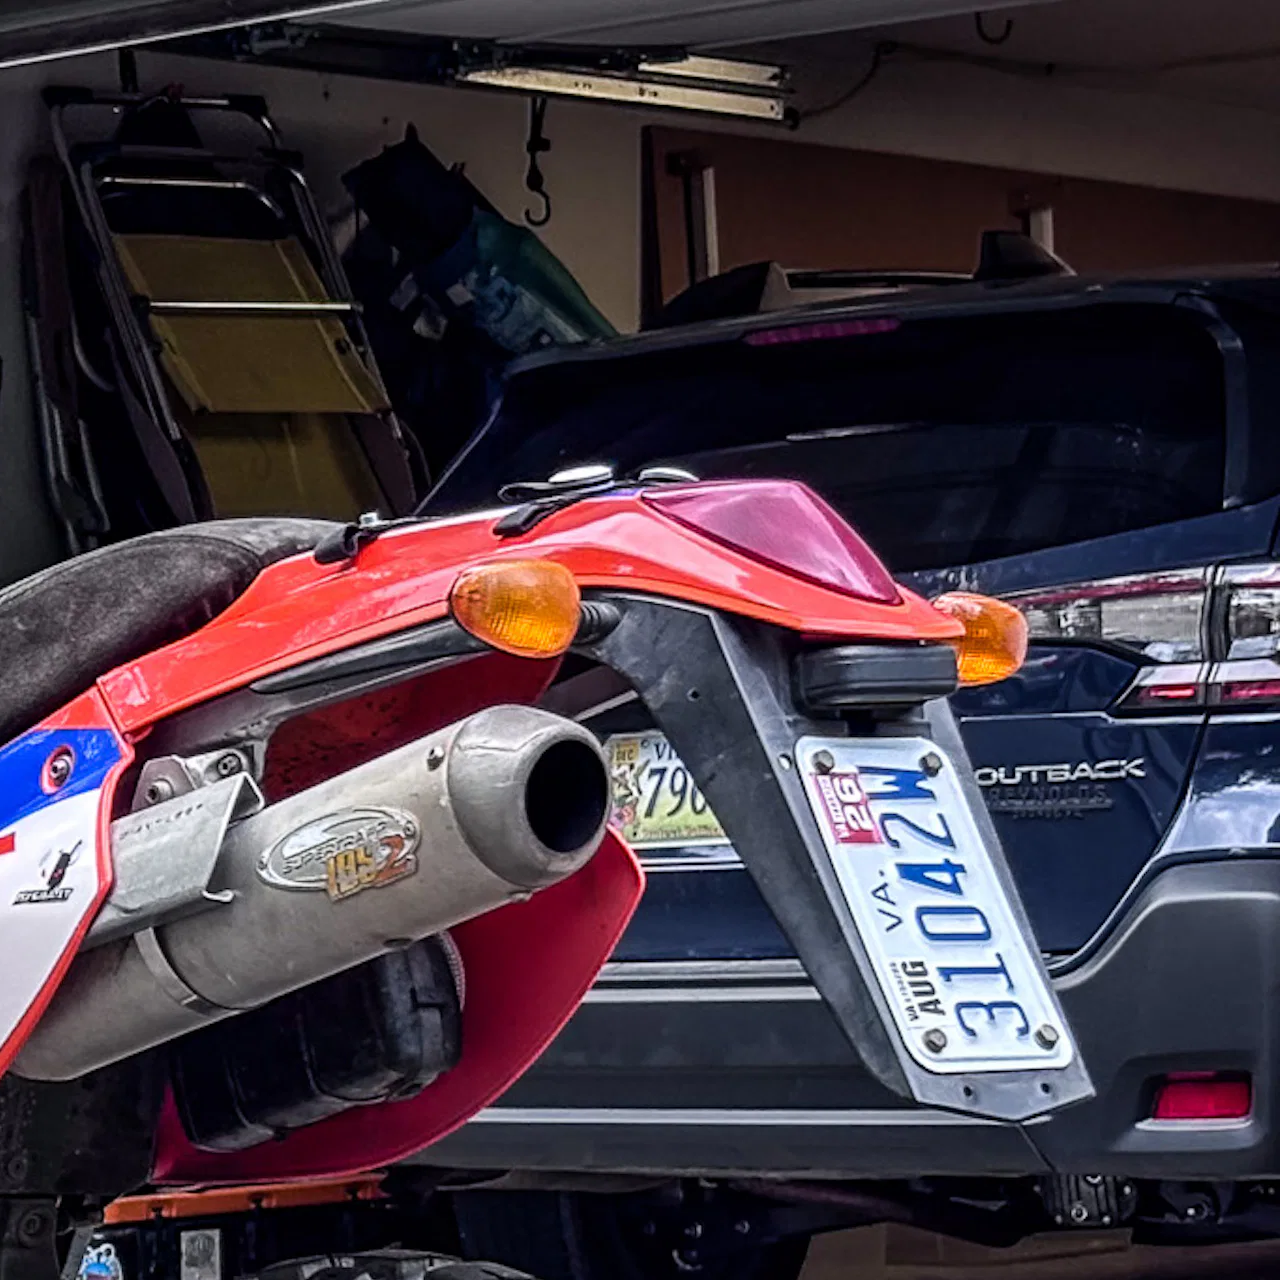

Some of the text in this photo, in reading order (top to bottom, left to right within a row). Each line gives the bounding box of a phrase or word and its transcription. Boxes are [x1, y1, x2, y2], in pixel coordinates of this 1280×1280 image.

[974, 758, 1146, 786] OUTBACK
[832, 776, 874, 832] 26
[901, 960, 946, 1016] AUG
